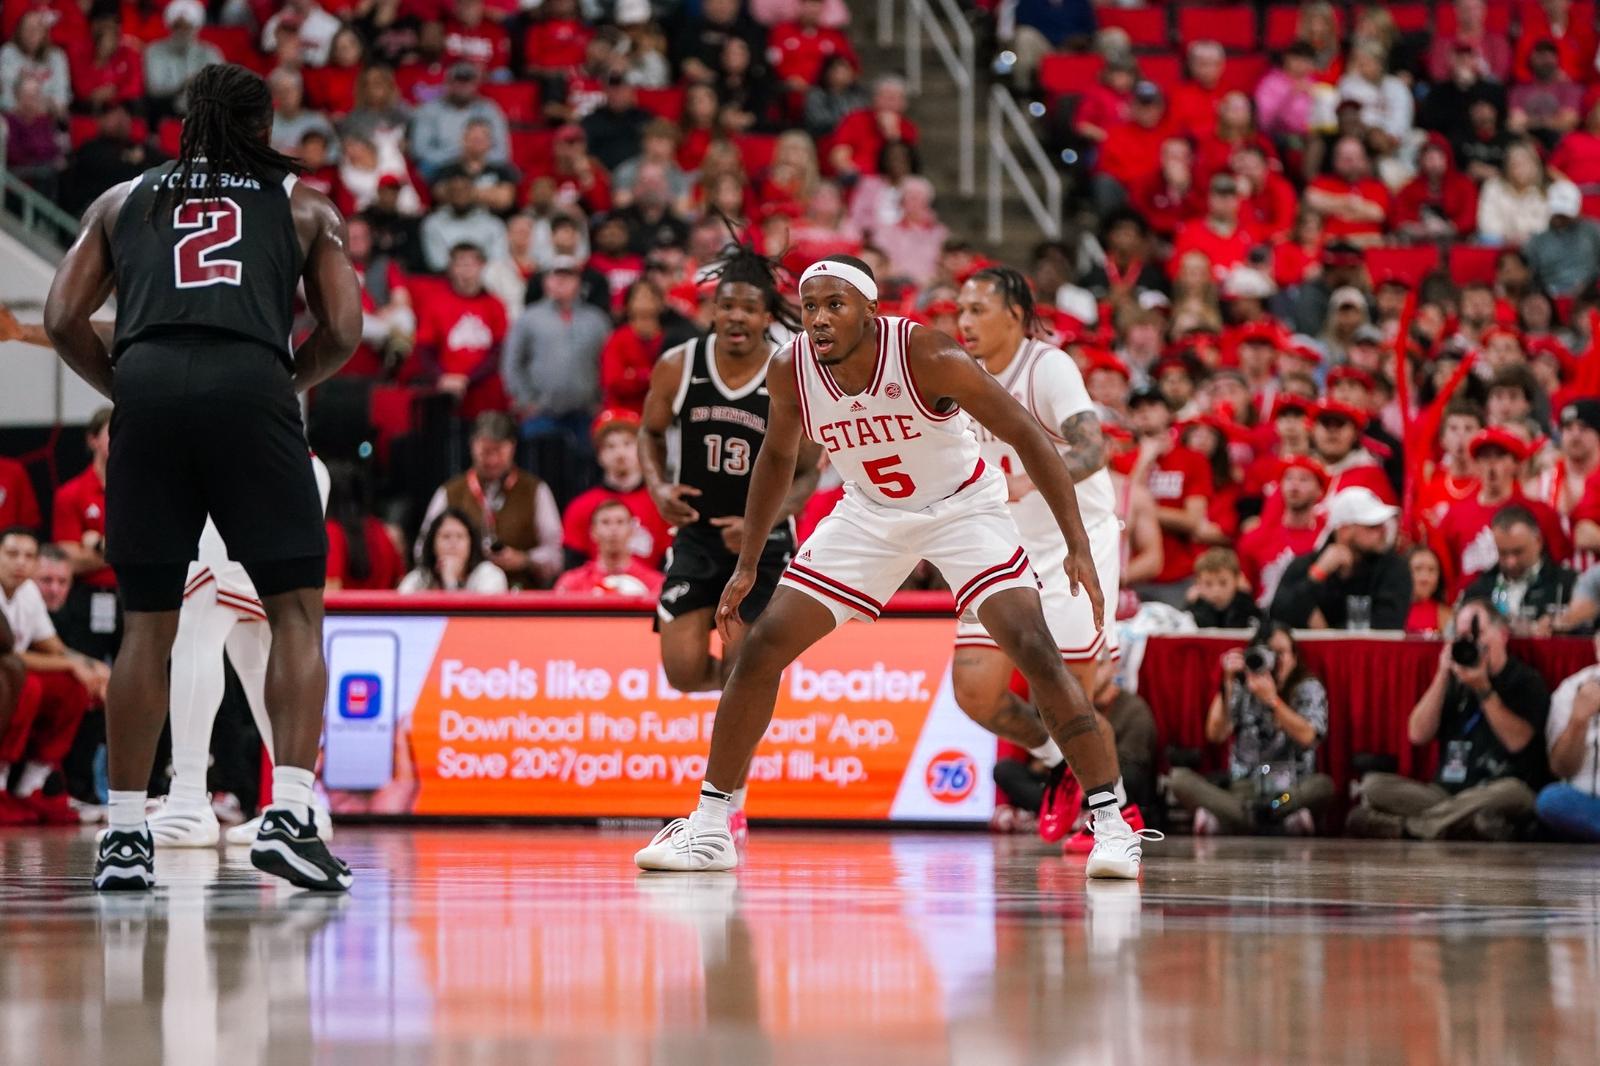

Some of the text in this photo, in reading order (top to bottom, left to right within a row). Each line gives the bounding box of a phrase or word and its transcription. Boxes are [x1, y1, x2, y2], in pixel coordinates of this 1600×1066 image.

[173, 197, 242, 289] 2
[711, 405, 767, 434] CENTRAL
[819, 414, 922, 453] STATE
[704, 434, 750, 476] 13
[862, 454, 916, 499] 5
[440, 659, 538, 700] Feels
[545, 659, 612, 700] like
[618, 668, 649, 700] a
[790, 661, 930, 701] beater.
[439, 710, 583, 742] Download
[589, 711, 637, 743] the
[640, 711, 699, 743] Fuel
[827, 712, 899, 750] App.
[437, 747, 508, 779] Save
[626, 756, 666, 779] on
[670, 756, 708, 786] yo
[933, 763, 969, 791] 76
